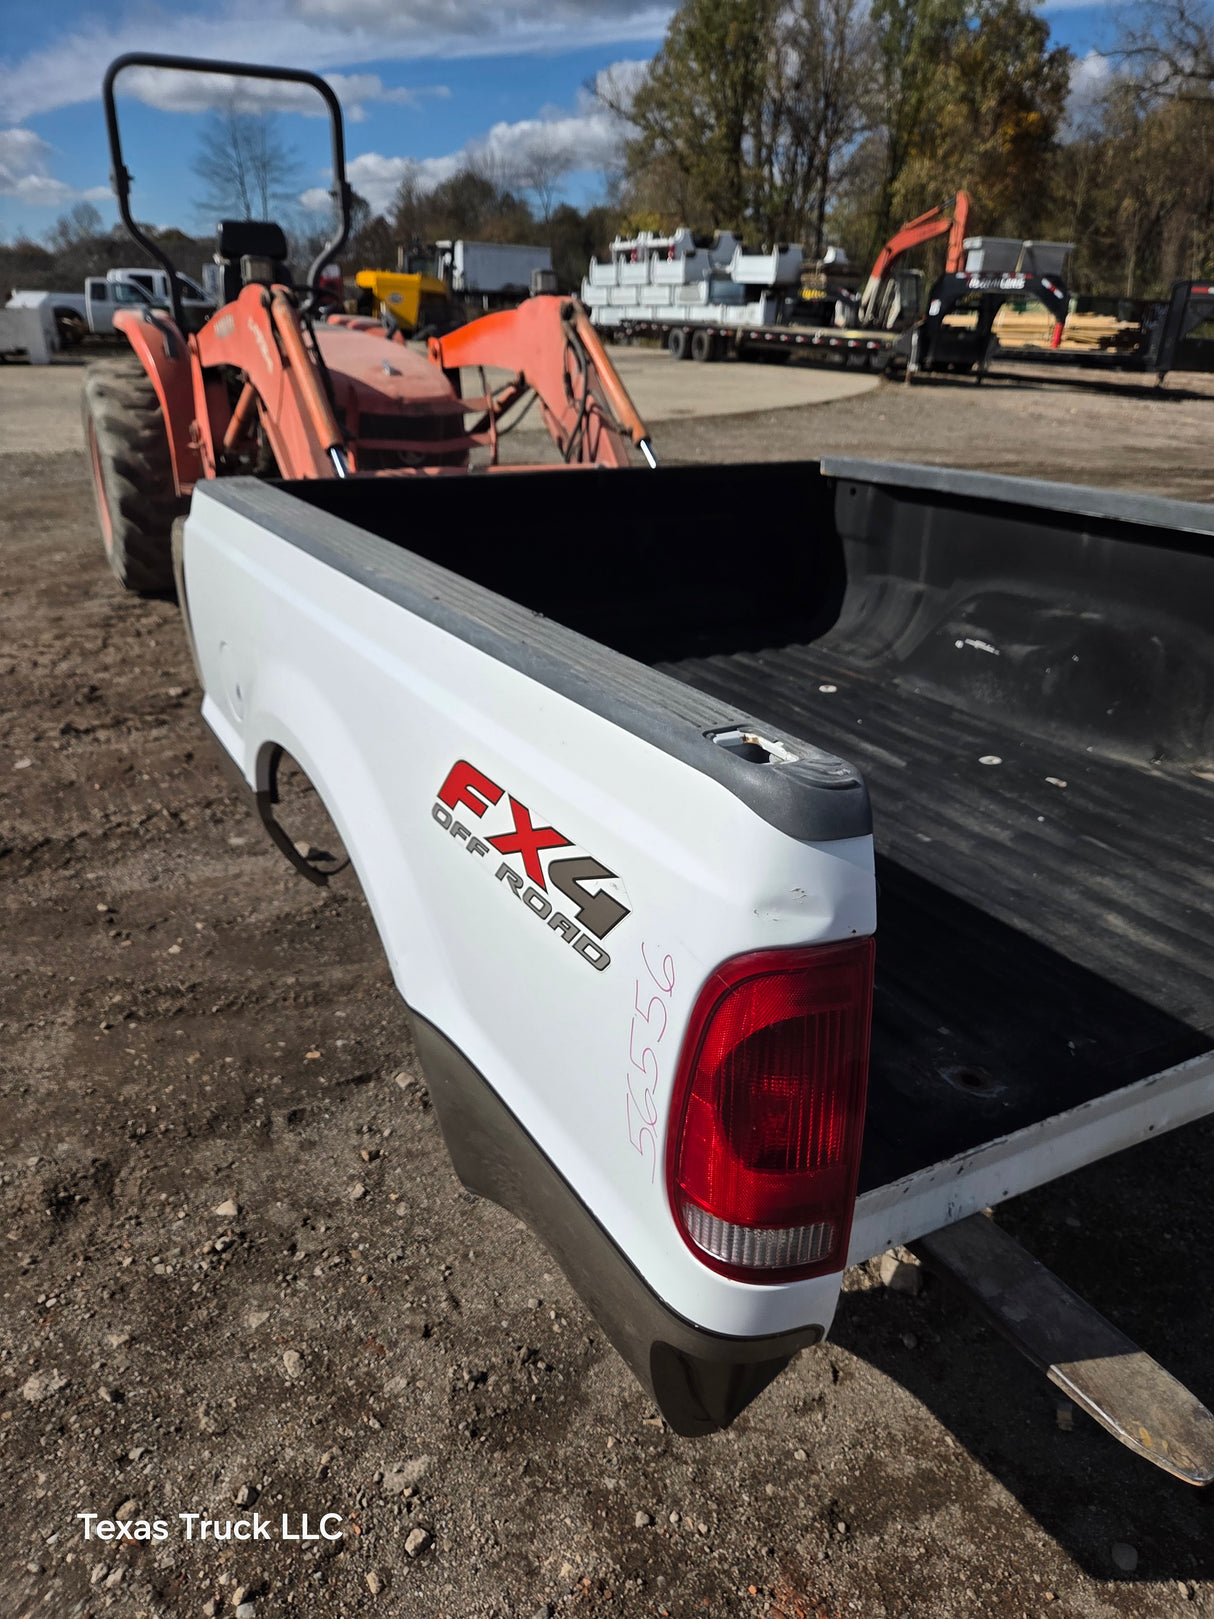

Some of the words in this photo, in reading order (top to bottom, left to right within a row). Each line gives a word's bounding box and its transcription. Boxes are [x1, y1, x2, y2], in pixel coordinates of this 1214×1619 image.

[431, 801, 490, 858] OFF
[495, 862, 612, 973] ROAD
[437, 759, 631, 940] FX4
[626, 941, 675, 1184] 56556
